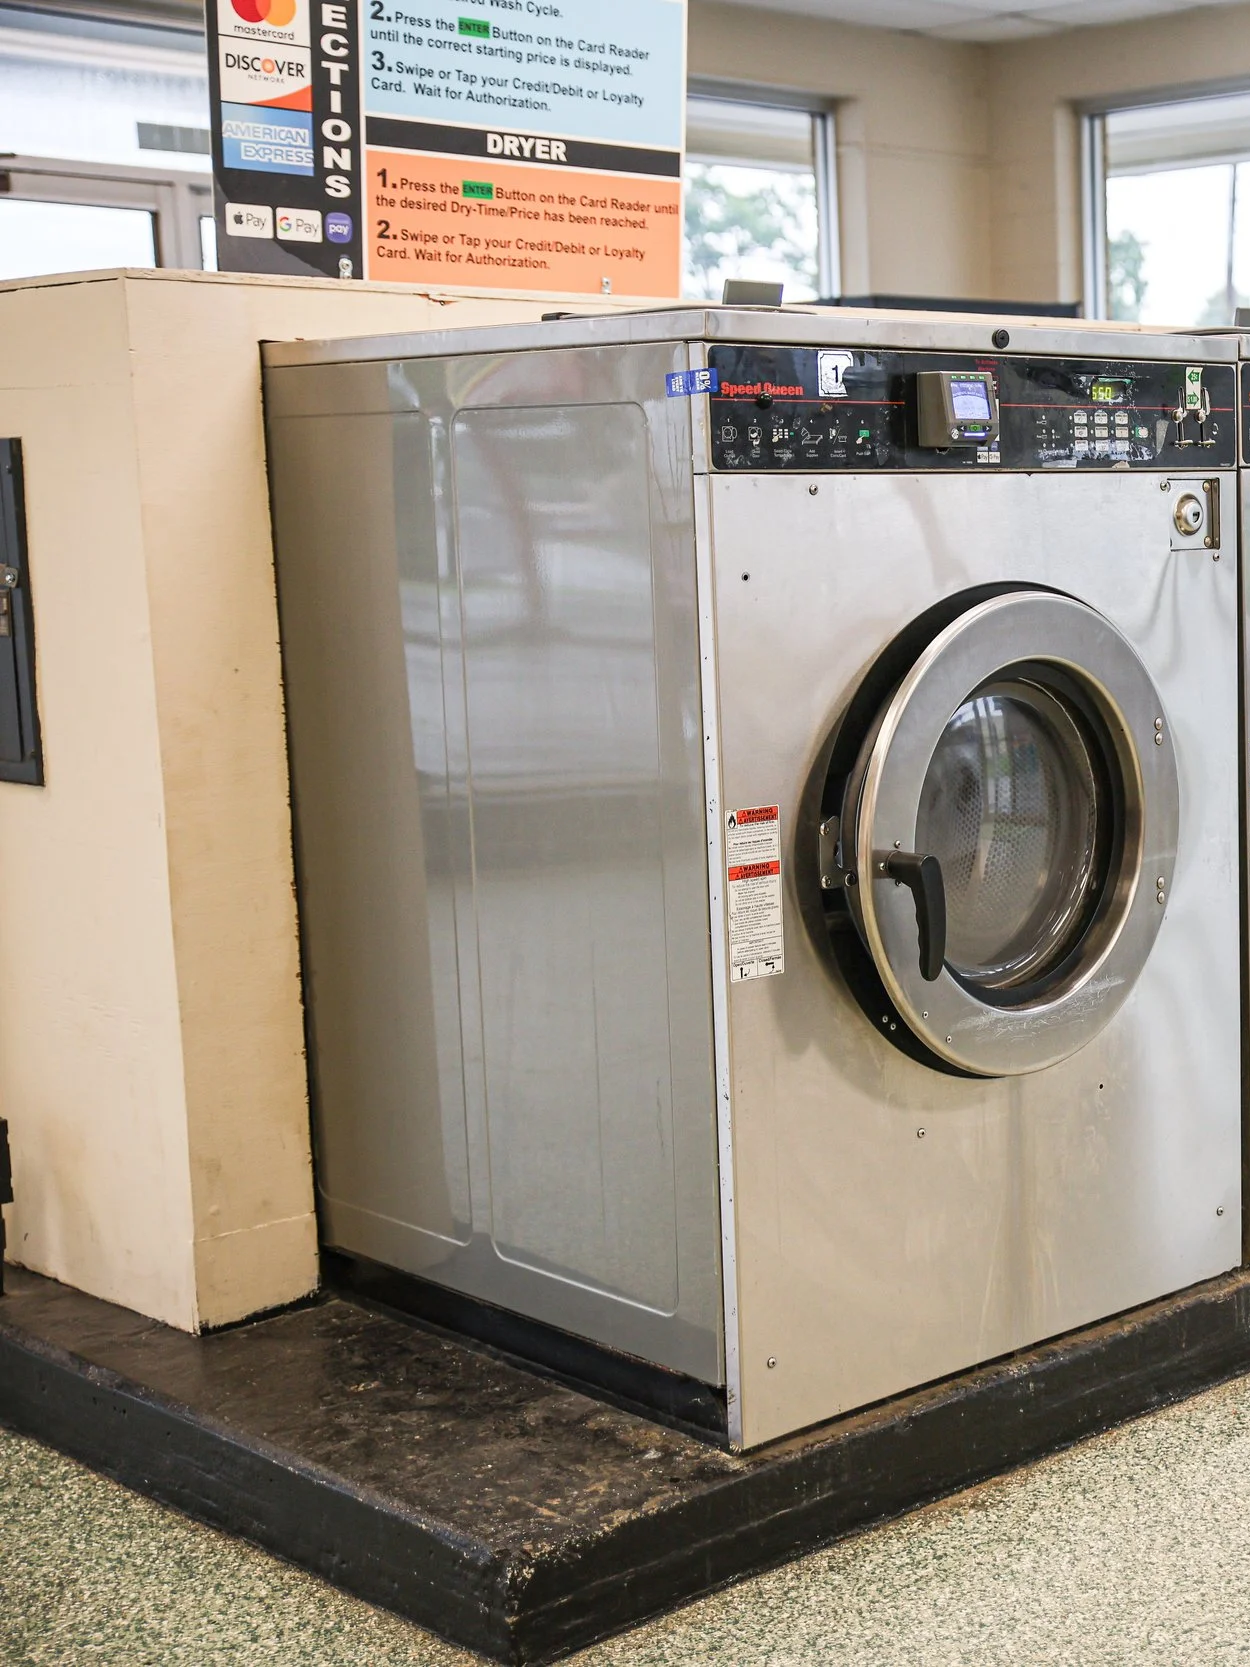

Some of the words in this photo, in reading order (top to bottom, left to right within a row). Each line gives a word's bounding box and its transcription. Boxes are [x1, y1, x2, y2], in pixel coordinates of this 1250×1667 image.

[526, 1, 564, 18] Cycle.
[233, 24, 295, 41] mastercard
[370, 0, 392, 22] 2.
[395, 11, 432, 28] Press
[436, 18, 456, 32] the
[459, 21, 490, 35] ENTER
[492, 26, 534, 43] Button
[537, 35, 552, 47] on
[555, 36, 574, 50] the
[577, 39, 606, 54] Card
[609, 44, 650, 61] Reader
[370, 29, 399, 42] until
[403, 34, 424, 46] the
[427, 38, 473, 54] correct
[476, 45, 524, 63] starting
[526, 51, 557, 66] price
[559, 57, 571, 68] is
[574, 57, 634, 77] displayed.
[225, 53, 305, 78] DISCOVER
[248, 74, 286, 85] NETWORK
[371, 50, 393, 73] 3.
[396, 61, 435, 79] Swipe
[438, 70, 452, 80] or
[455, 69, 478, 86] Tap
[481, 74, 508, 89] your
[512, 77, 584, 98] Credit/Debit
[586, 90, 599, 100] or
[602, 89, 645, 109] Loyalty
[320, 0, 351, 199] ECTIONS
[371, 77, 406, 94] Card.
[413, 82, 442, 98] Wait
[445, 87, 463, 100] for
[466, 90, 552, 112] Authorization.
[222, 121, 307, 145] AMERICAN
[242, 144, 314, 166] EXPRESS
[486, 132, 568, 163] DRYER
[376, 167, 397, 189] 1.
[400, 177, 437, 193] Press
[440, 181, 460, 195] the
[462, 183, 493, 196] ENTER
[495, 187, 532, 202] Button
[539, 193, 555, 204] on
[558, 192, 577, 206] the
[579, 195, 608, 209] Card
[610, 198, 651, 213] Reader
[654, 203, 679, 216] until
[246, 212, 267, 230] Pay
[376, 194, 397, 208] the
[399, 197, 447, 212] desired
[451, 201, 541, 220] Dry-Time/Price
[543, 209, 565, 223] has
[568, 212, 598, 226] been
[600, 216, 650, 230] reached.
[296, 218, 320, 238] Pay
[328, 223, 350, 236] pay
[376, 219, 398, 240] 2.
[400, 228, 439, 245] Swipe
[442, 236, 456, 245] or
[459, 233, 482, 248] Tap
[485, 238, 512, 250] your
[515, 237, 586, 255] Credit/Debit
[588, 246, 601, 256] or
[603, 245, 646, 262] Loyalty
[376, 245, 411, 260] Card.
[414, 248, 442, 262] Wait
[445, 251, 463, 264] for
[465, 253, 551, 270] Authorization.
[831, 364, 840, 384] 1
[720, 382, 762, 398] Speed
[763, 382, 804, 396] Queen
[747, 807, 773, 816] WARNING
[743, 863, 770, 871] WARNING
